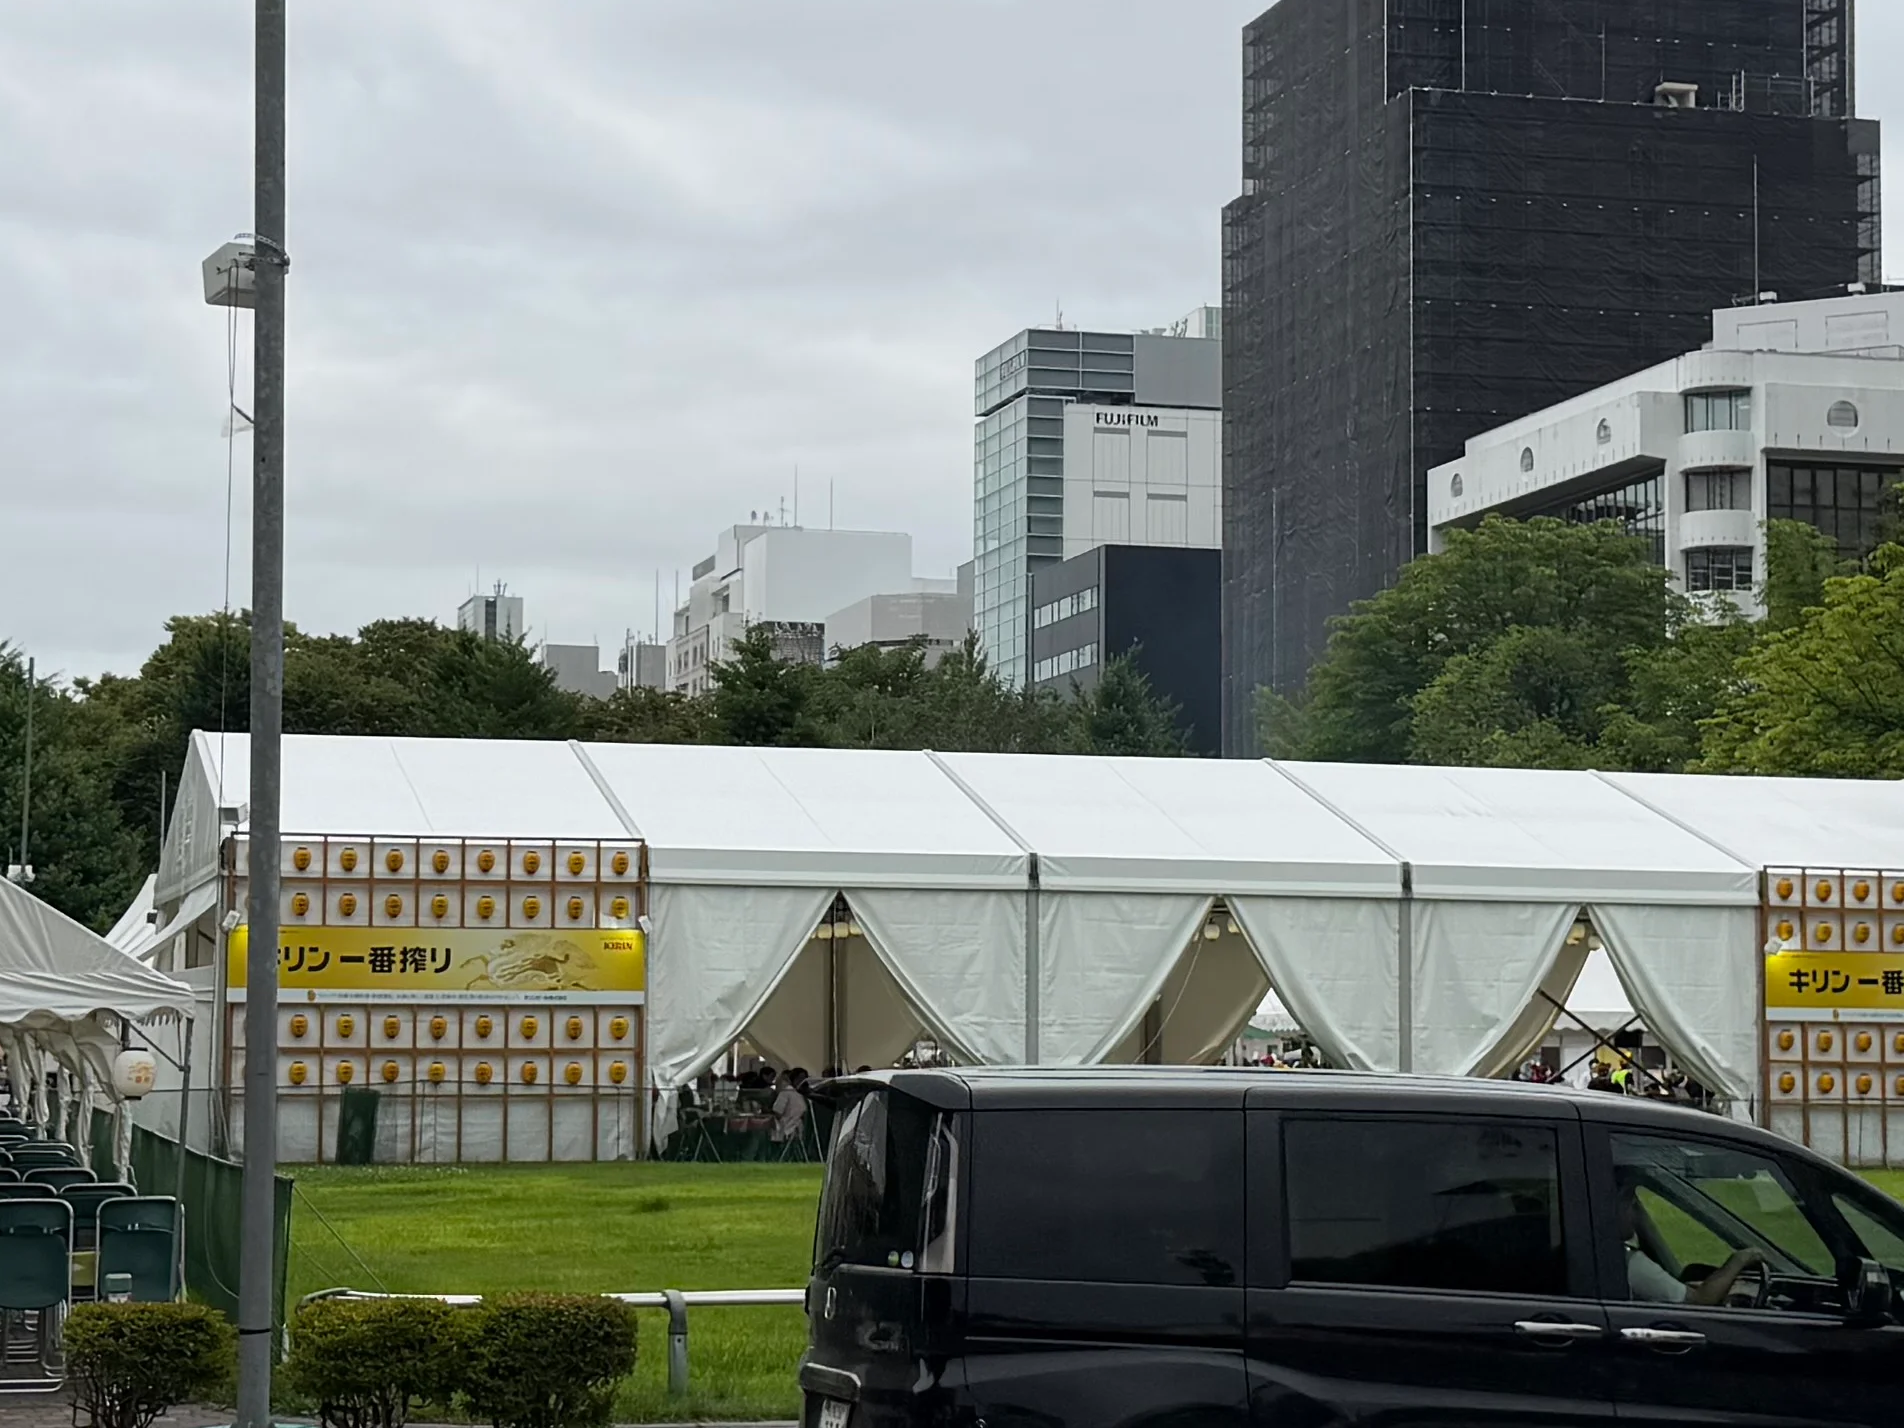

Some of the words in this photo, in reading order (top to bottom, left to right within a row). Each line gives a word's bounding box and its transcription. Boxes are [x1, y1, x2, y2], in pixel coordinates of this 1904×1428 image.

[1096, 412, 1159, 427] FUJIFILM
[277, 946, 452, 973] リン一番搾り
